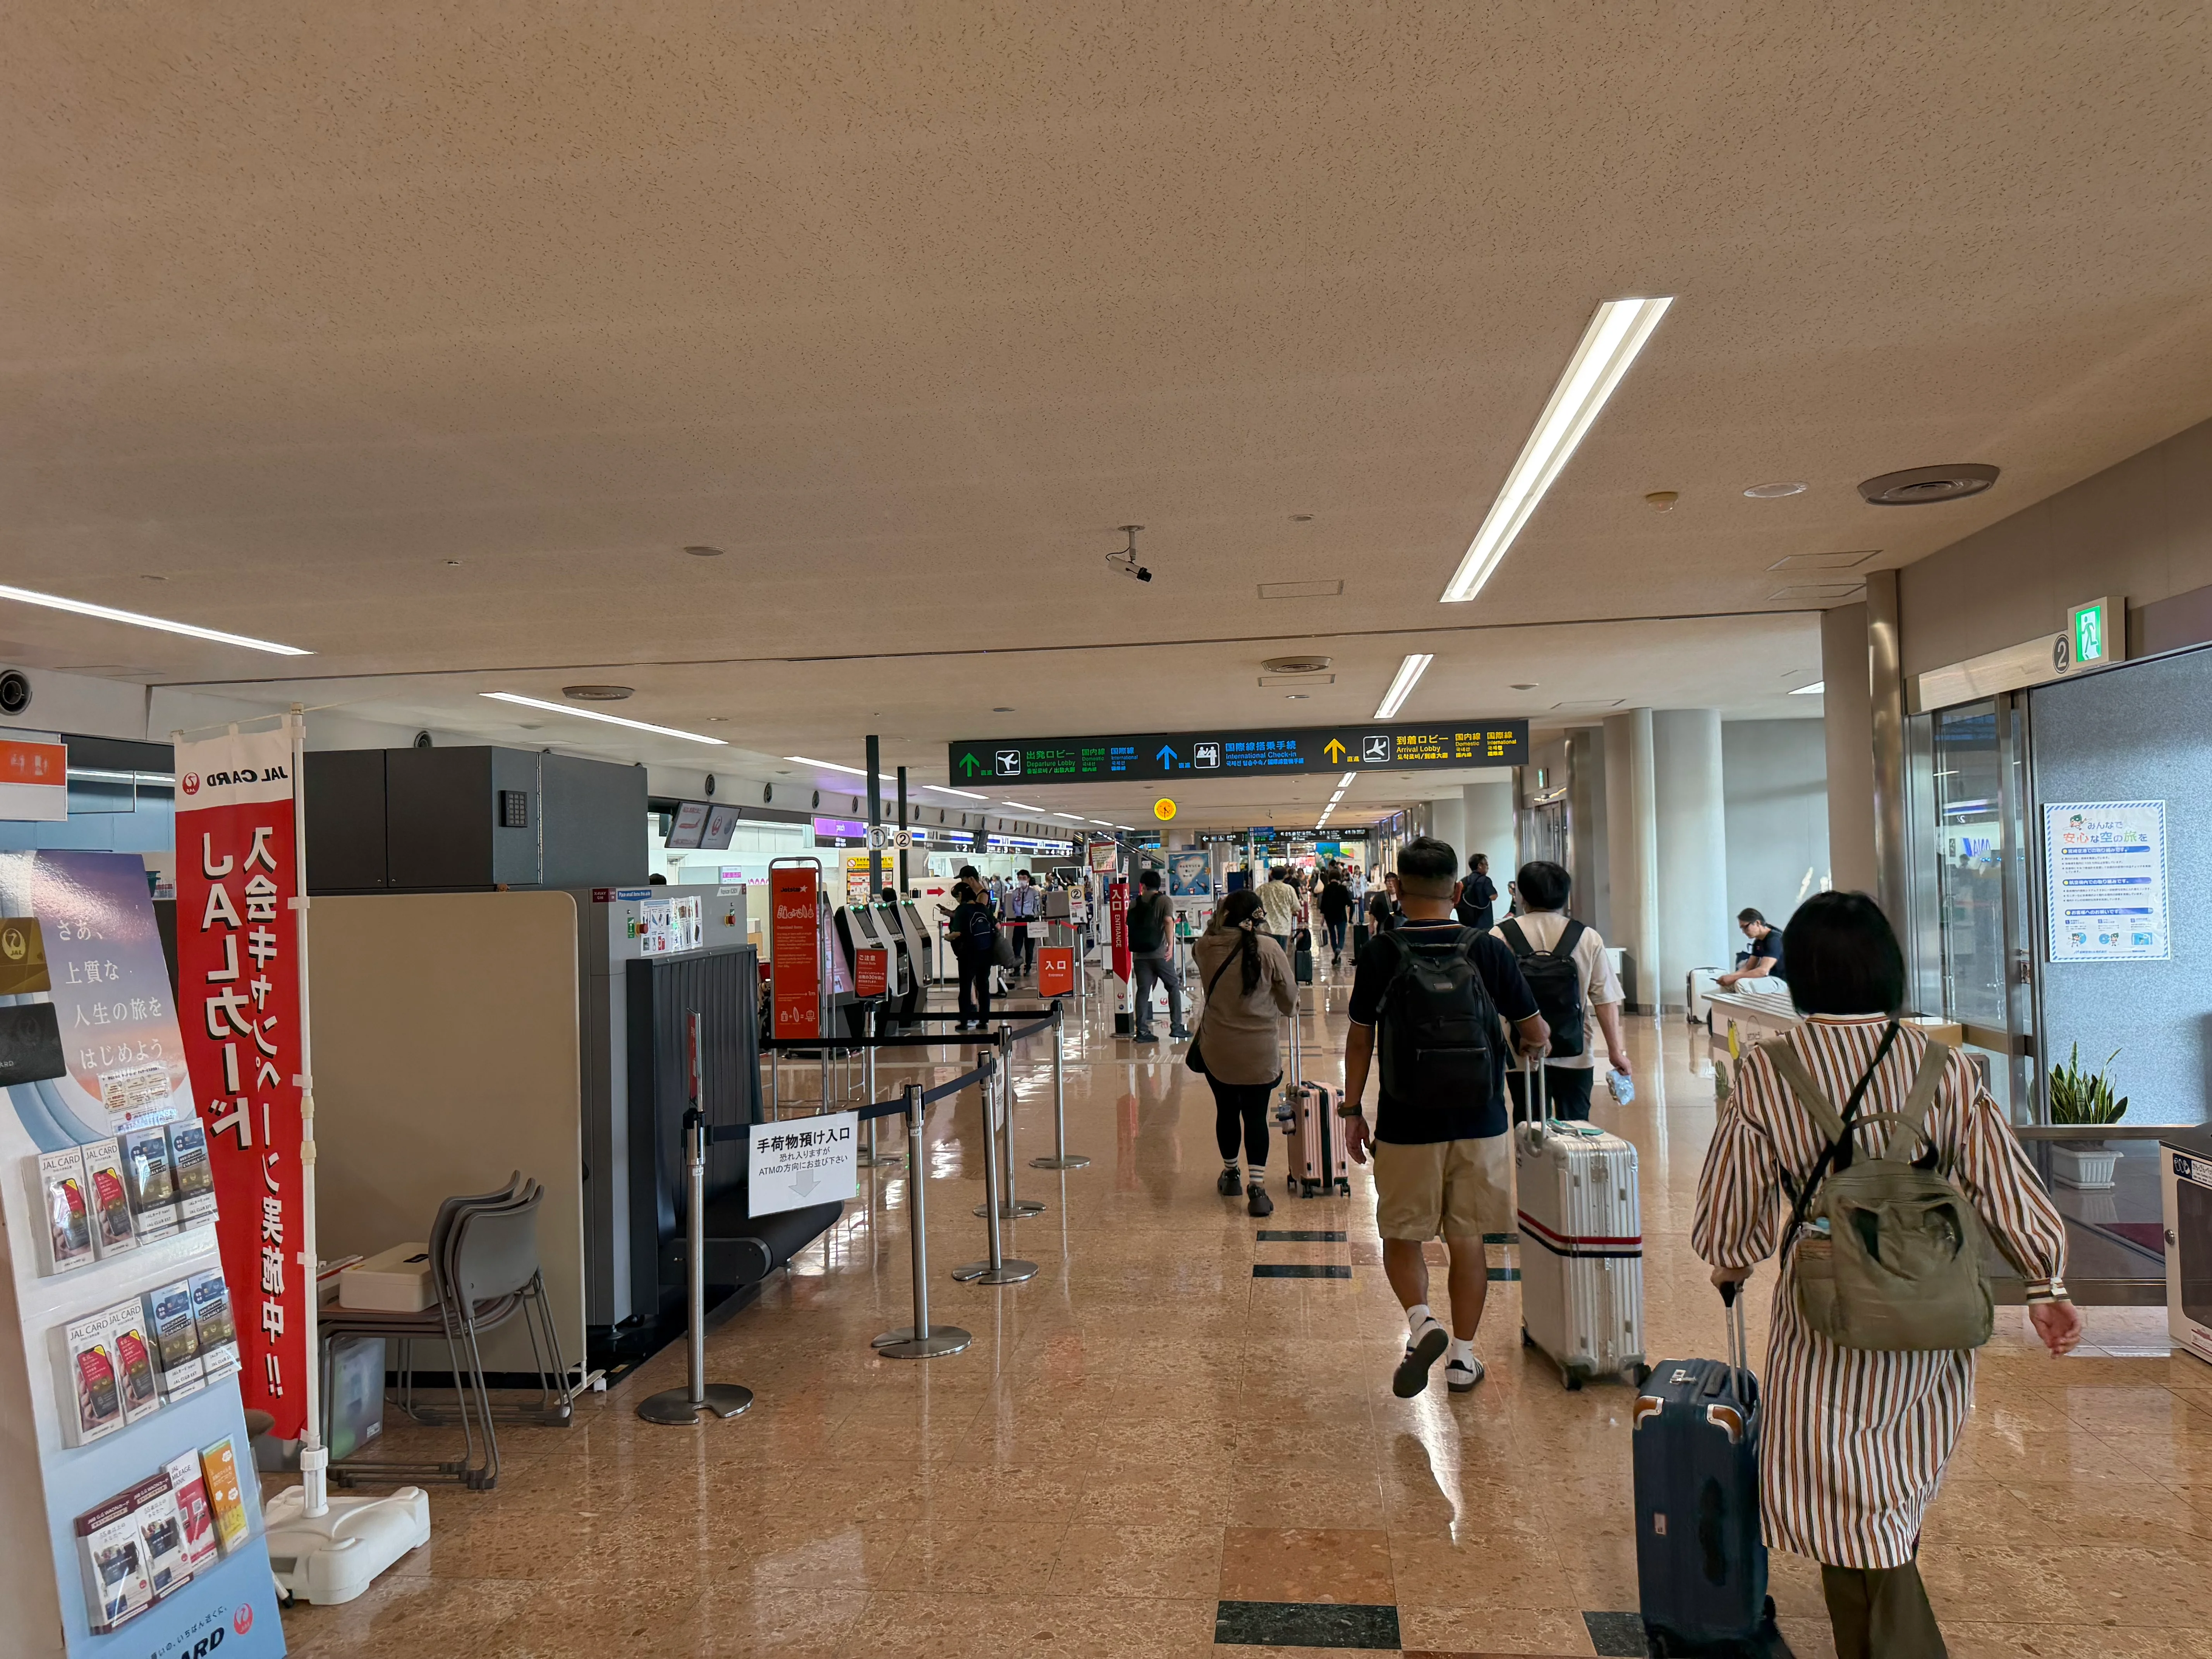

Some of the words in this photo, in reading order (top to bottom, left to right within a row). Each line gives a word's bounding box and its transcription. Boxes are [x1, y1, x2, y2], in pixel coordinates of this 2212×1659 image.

[2057, 641, 2067, 668] 2
[1396, 734, 1449, 745] 到着ロビー
[1455, 732, 1480, 741] 国内線
[1487, 731, 1512, 740] 国際線
[1026, 750, 1075, 759] 出発ロビー
[1225, 740, 1296, 752] 国際線搭乗手続
[2087, 821, 2123, 830] みんなで
[2063, 830, 2148, 844] 安心な空の旅を
[1112, 889, 1122, 911] 入口
[56, 920, 105, 940] さあ、
[65, 960, 119, 985] 上質な
[1045, 961, 1066, 970] 入口
[74, 995, 163, 1029] 人生の旅を
[79, 1038, 163, 1070] はじめよう
[757, 1127, 850, 1154] 手荷物預け入口
[86, 1150, 98, 1160] JAL
[98, 1145, 118, 1156] CARD
[779, 1146, 830, 1163] 恐れ入りますが
[42, 1160, 58, 1171] JAL
[58, 1154, 80, 1166] CARD
[759, 1155, 848, 1176] ATMの方向にお並び下さい
[109, 1314, 120, 1325] JAL
[120, 1305, 141, 1319] CARD
[70, 1329, 85, 1341] JAL
[86, 1320, 108, 1333] CARD
[172, 1465, 191, 1480] MILEAGE
[173, 1477, 186, 1489] BANK
